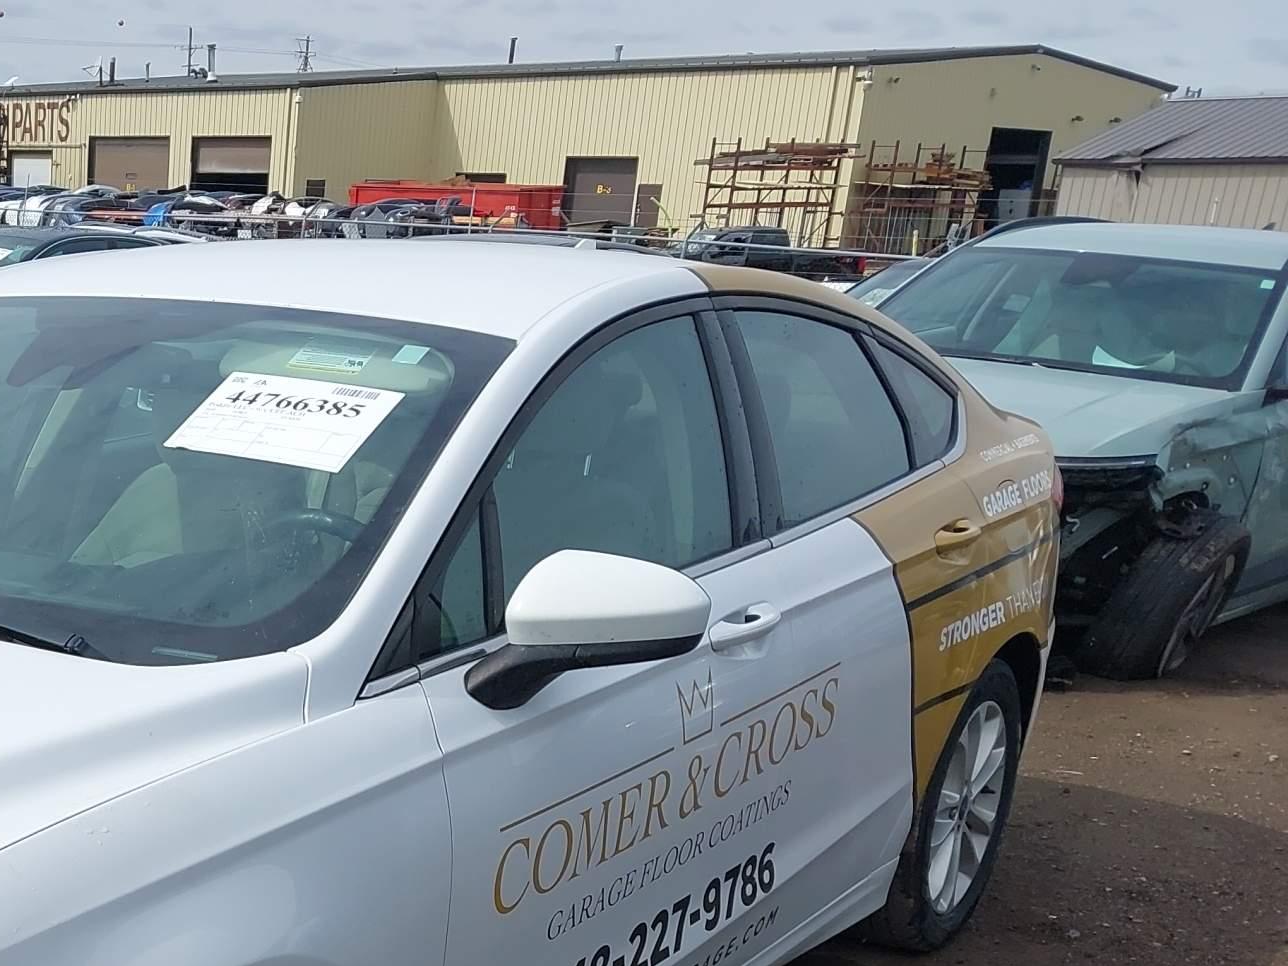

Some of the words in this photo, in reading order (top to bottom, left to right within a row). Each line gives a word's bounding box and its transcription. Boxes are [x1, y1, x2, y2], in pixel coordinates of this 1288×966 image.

[12, 100, 71, 142] PARTS
[225, 389, 367, 418] 44766385
[982, 484, 1023, 517] GARAGE
[939, 601, 1006, 652] STRONGER
[493, 769, 671, 915] COMER
[679, 754, 712, 820] &
[713, 677, 840, 799] CROSS
[546, 869, 638, 941] GARAGE
[638, 831, 706, 890] FLOOR
[708, 779, 793, 849] COATINGS
